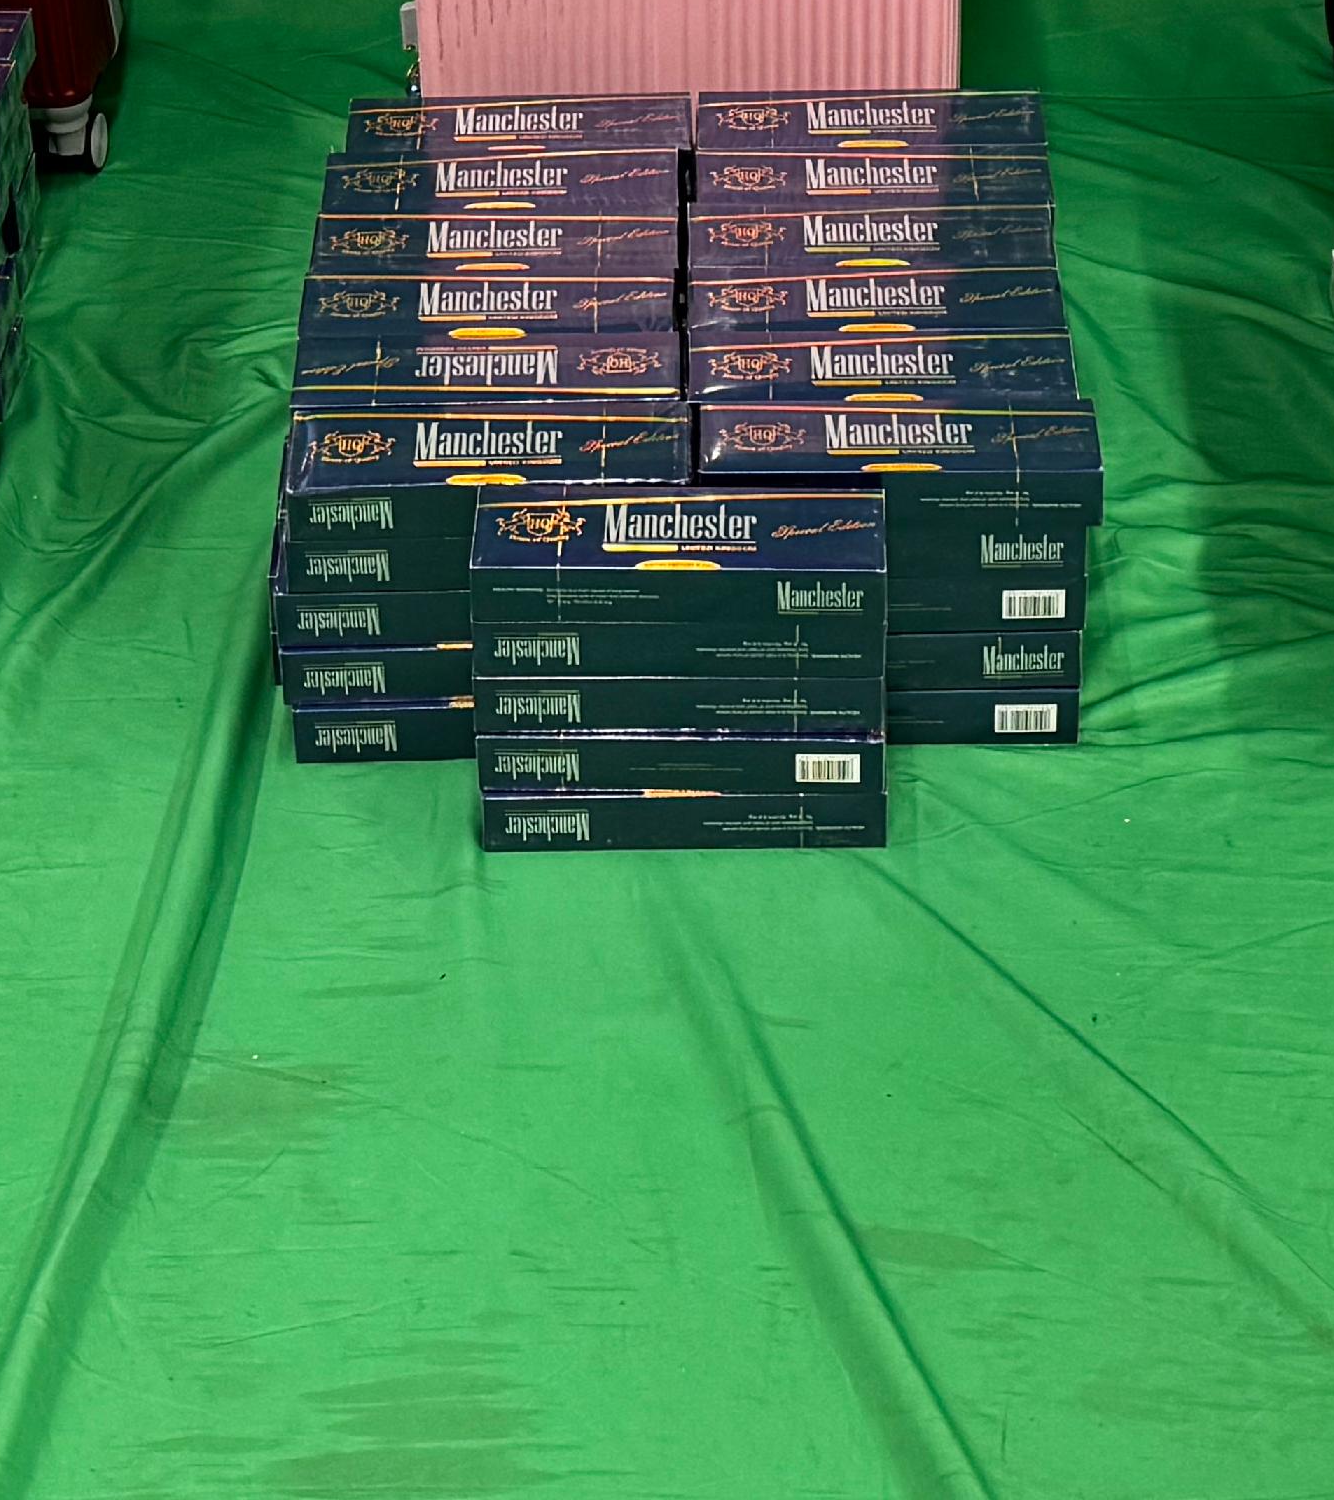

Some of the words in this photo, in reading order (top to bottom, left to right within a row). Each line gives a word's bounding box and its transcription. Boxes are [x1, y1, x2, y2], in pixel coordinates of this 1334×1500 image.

[455, 106, 584, 135] Manchester
[807, 101, 936, 129] Manchester
[436, 160, 568, 192] Manchester
[806, 158, 938, 189] Manchester
[427, 220, 563, 252] Manchester
[804, 214, 939, 246] Manchester
[419, 282, 558, 316] Manchester
[805, 279, 945, 312] Manchester
[415, 350, 559, 385] Manchester
[810, 345, 954, 380] Manchester
[414, 422, 563, 461] Manchester
[824, 414, 973, 449] Manchester
[604, 503, 758, 542] Manchester
[981, 533, 1065, 564] Manchester
[777, 581, 864, 611] Manchester
[983, 644, 1066, 674] Manchester
